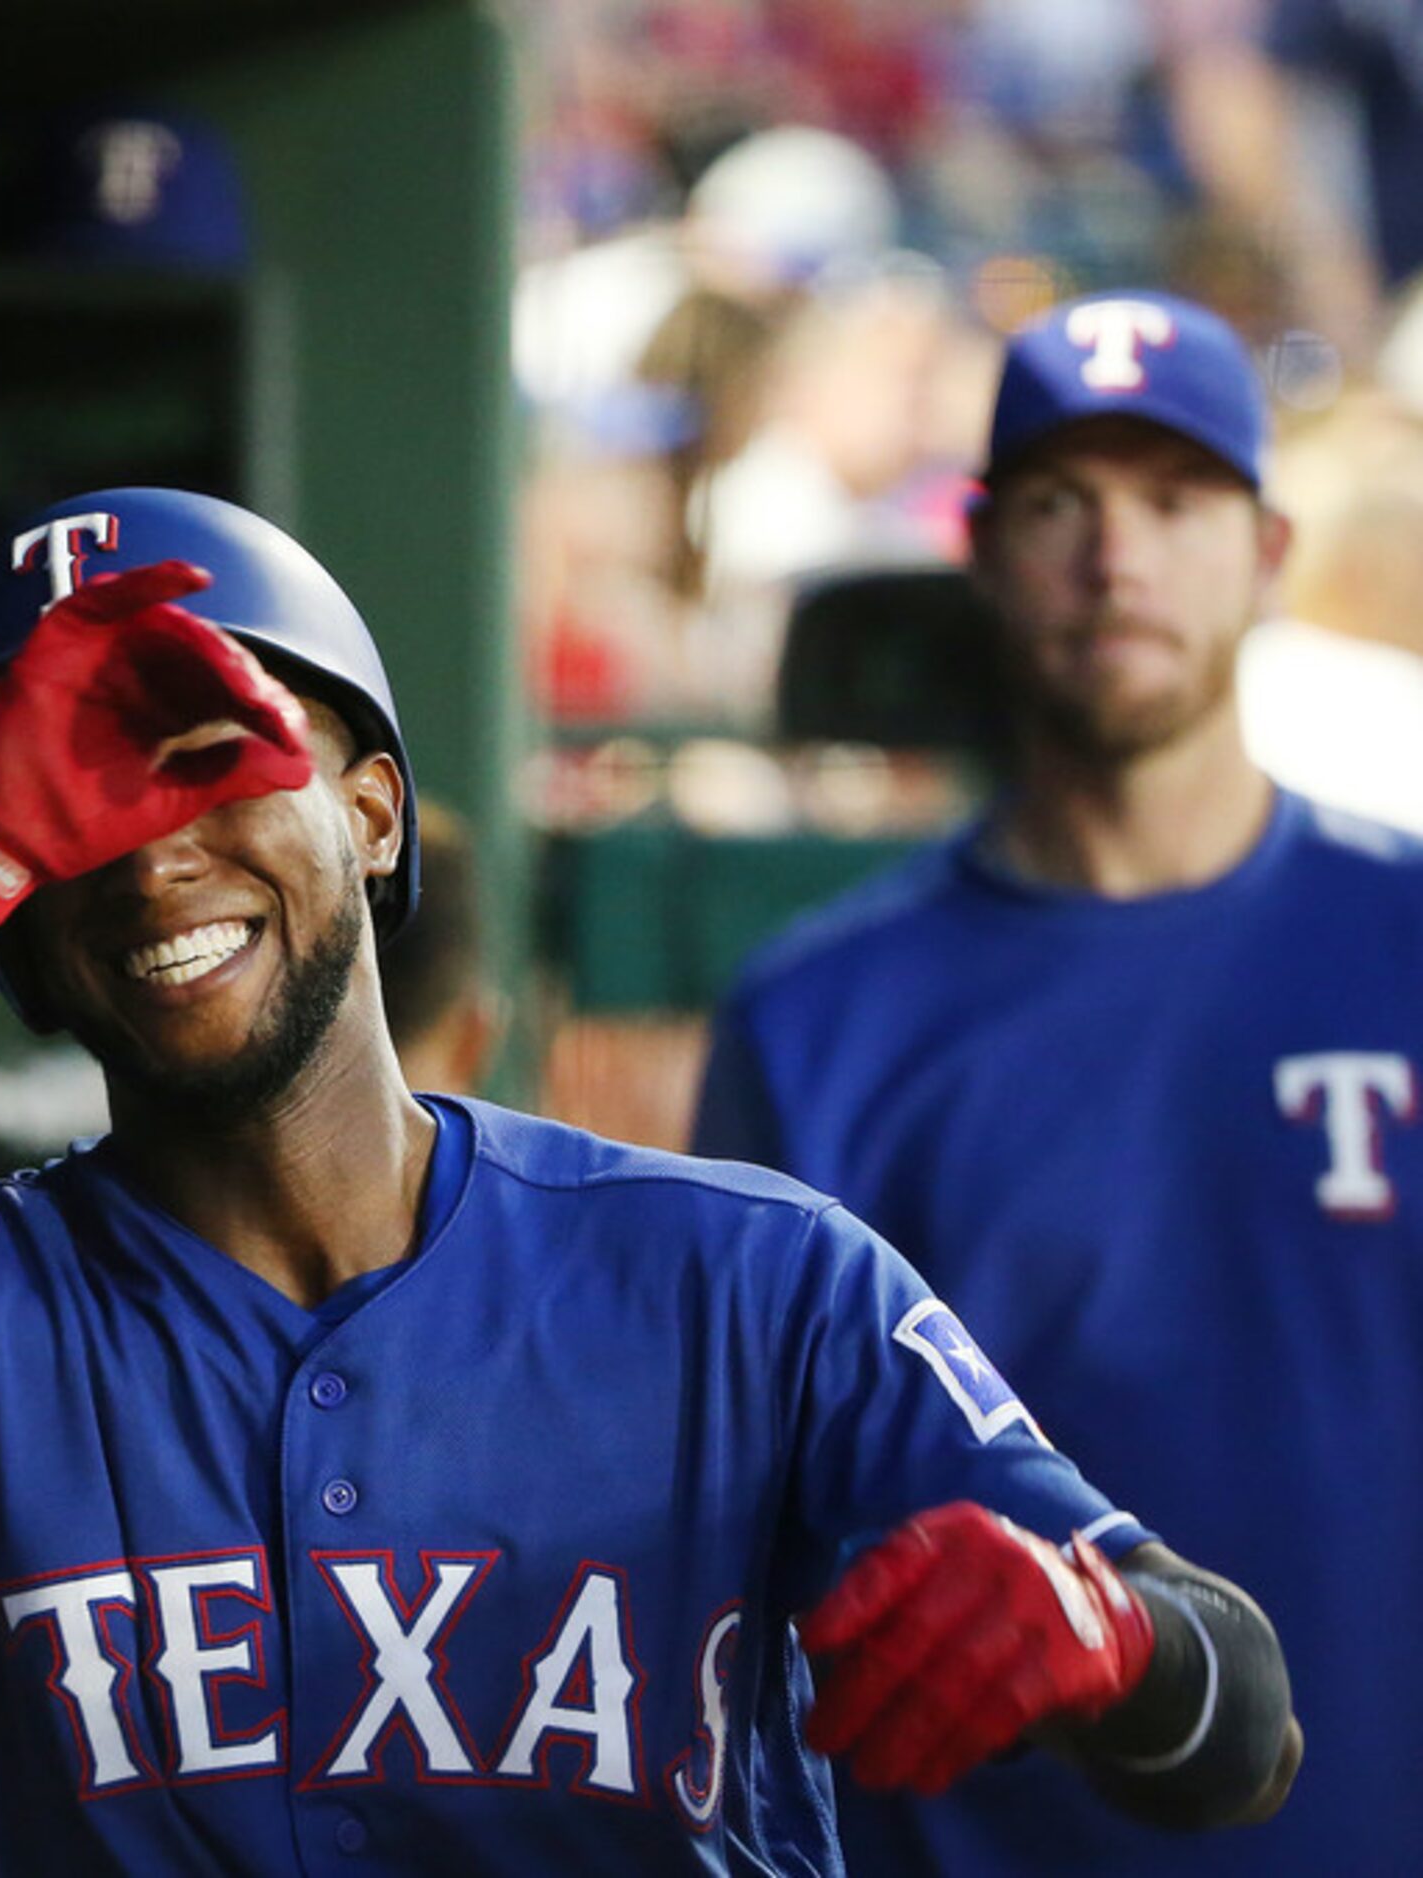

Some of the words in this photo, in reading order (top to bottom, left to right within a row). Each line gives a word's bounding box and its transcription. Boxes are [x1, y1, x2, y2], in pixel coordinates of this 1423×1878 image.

[1066, 299, 1178, 396] T
[11, 512, 119, 615] T
[1273, 1050, 1419, 1222] T
